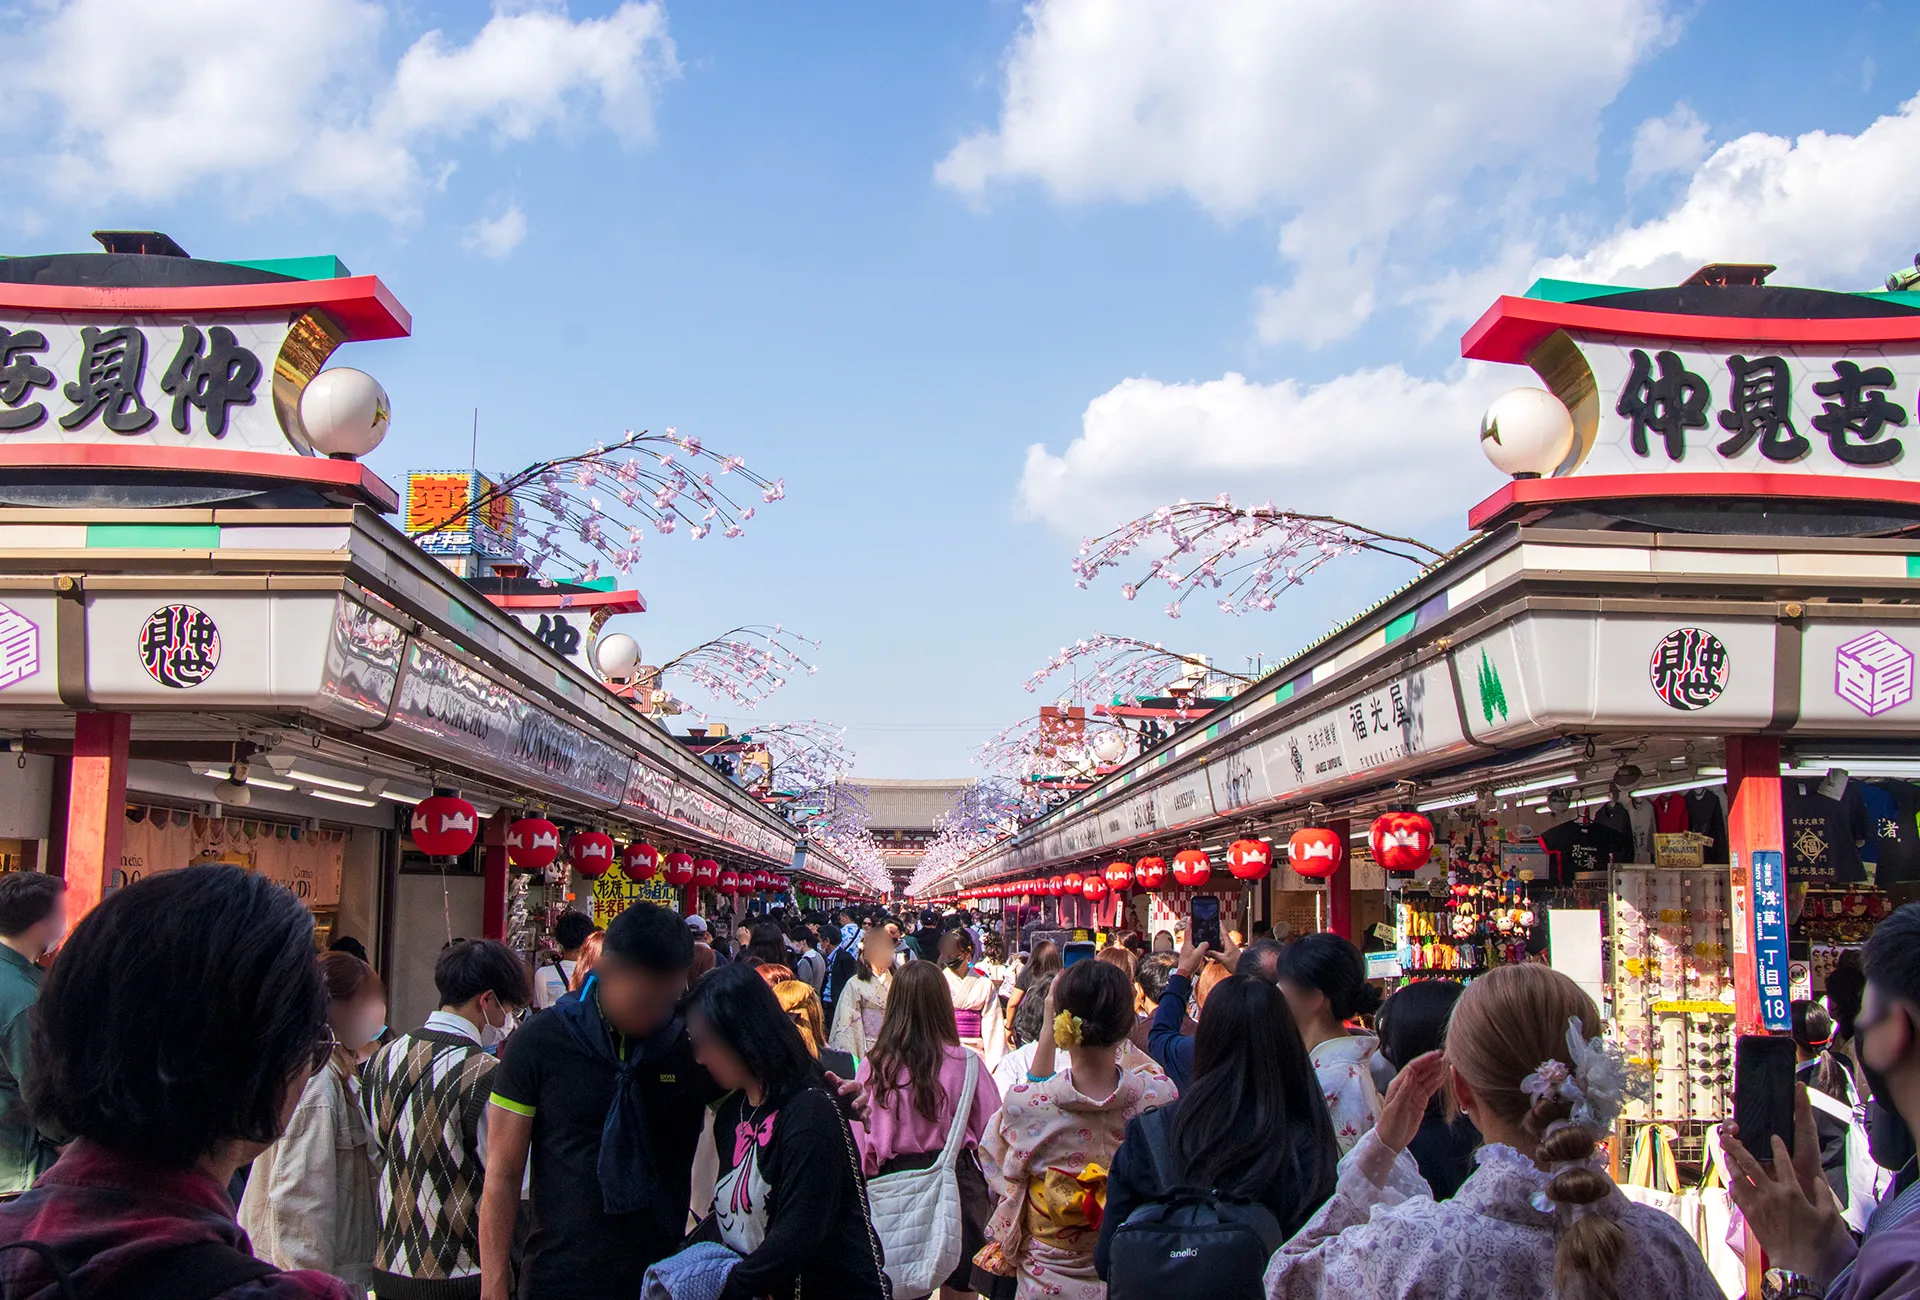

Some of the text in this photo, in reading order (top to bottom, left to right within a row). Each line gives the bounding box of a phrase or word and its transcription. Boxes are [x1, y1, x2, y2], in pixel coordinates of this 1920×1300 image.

[410, 477, 468, 527] 薬
[427, 698, 491, 740] Cosmetics
[1350, 684, 1410, 742] 福光屋
[1762, 891, 1780, 985] 浅草一丁目
[1764, 999, 1785, 1018] 18
[1170, 1248, 1198, 1258] anello
